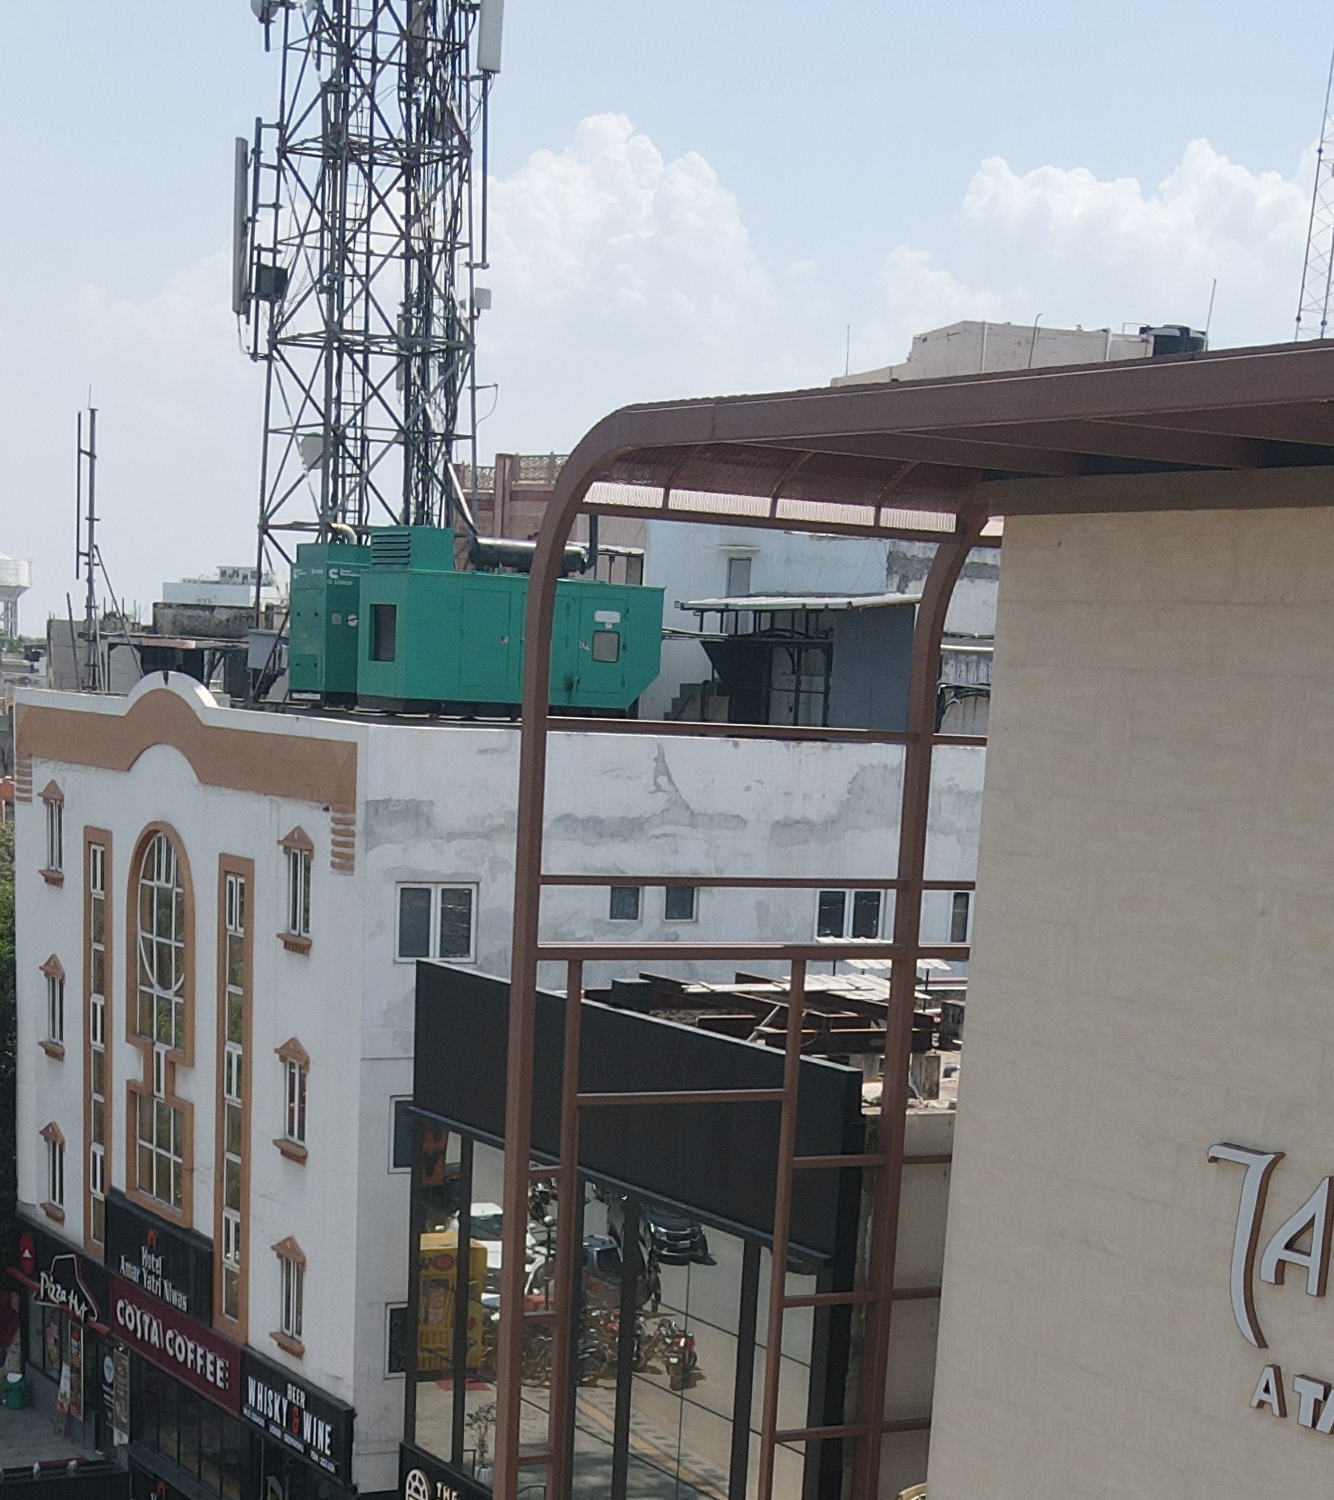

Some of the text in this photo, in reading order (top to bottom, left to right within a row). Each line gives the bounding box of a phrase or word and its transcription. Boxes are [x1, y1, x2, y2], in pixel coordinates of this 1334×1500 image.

[40, 1271, 67, 1304] Pizza
[120, 1254, 188, 1312] Amar Yatri Niwas
[141, 1246, 163, 1275] Hotel
[117, 1299, 229, 1390] COSTA COFFEE
[248, 1375, 287, 1428] WHISKY
[303, 1410, 332, 1456] WINE
[287, 1383, 305, 1409] BEER
[1249, 1364, 1287, 1418] A
